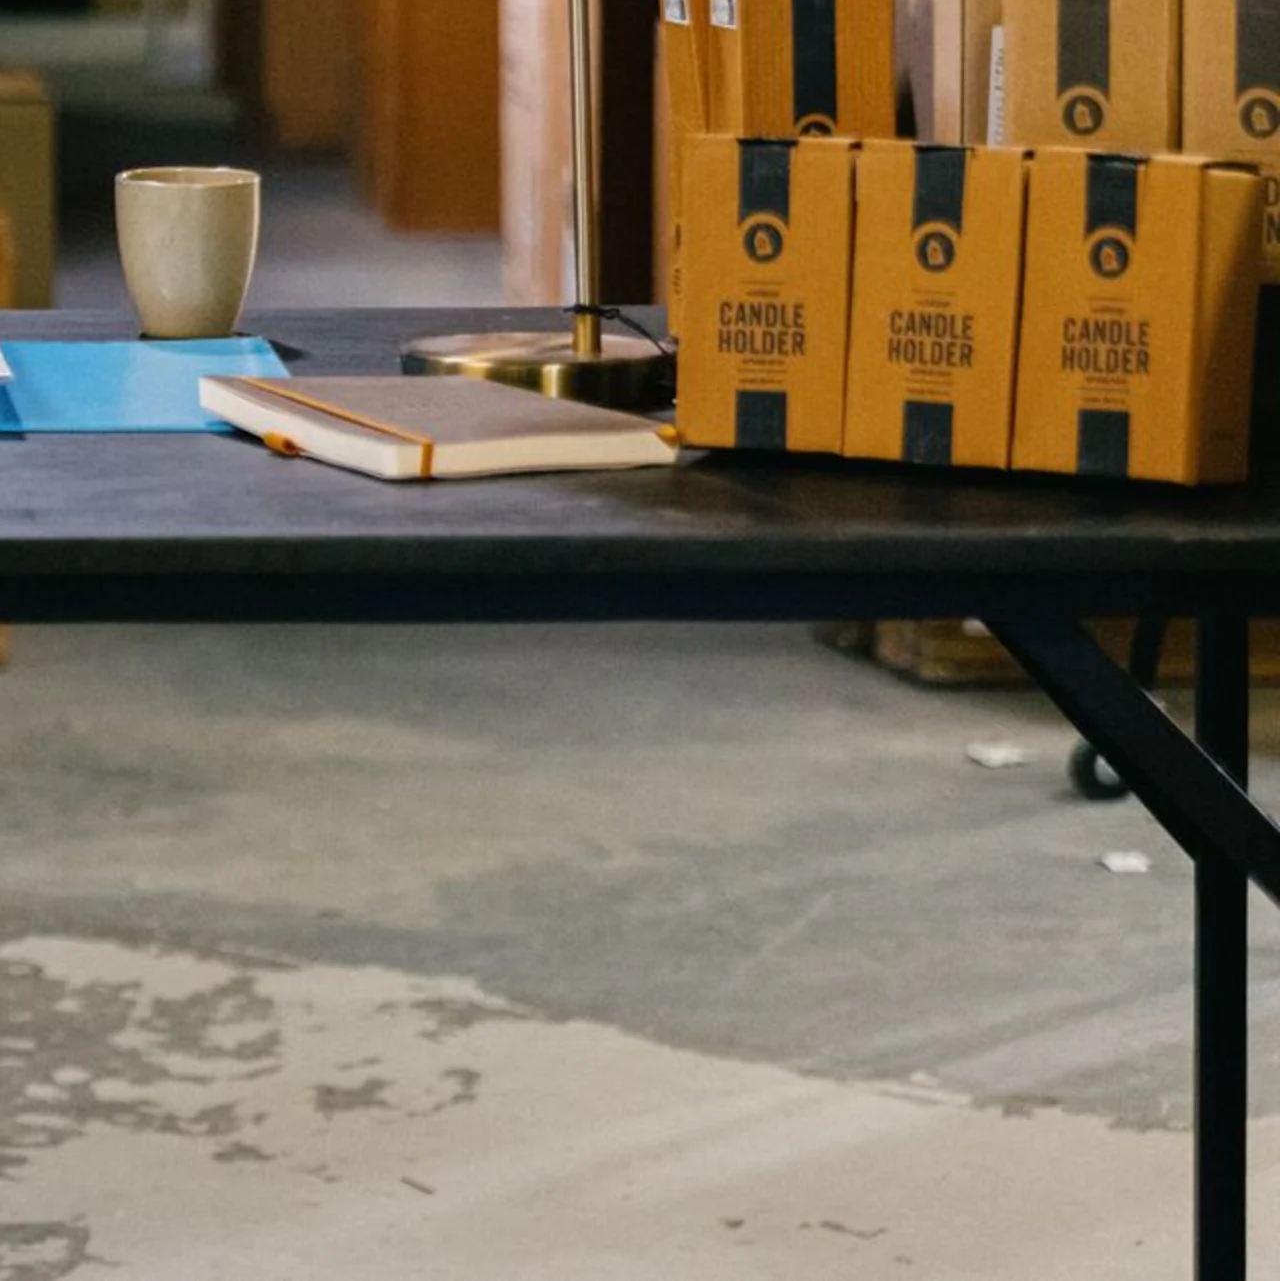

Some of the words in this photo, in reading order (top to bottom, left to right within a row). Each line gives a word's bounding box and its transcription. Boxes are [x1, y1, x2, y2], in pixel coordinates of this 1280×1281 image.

[719, 301, 806, 329] CANDLE
[889, 310, 975, 341] CANDLE
[718, 329, 807, 356] HOLDER
[1063, 317, 1151, 347] CANDLE
[887, 337, 974, 369] HOLDER
[1061, 345, 1151, 376] HOLDER
